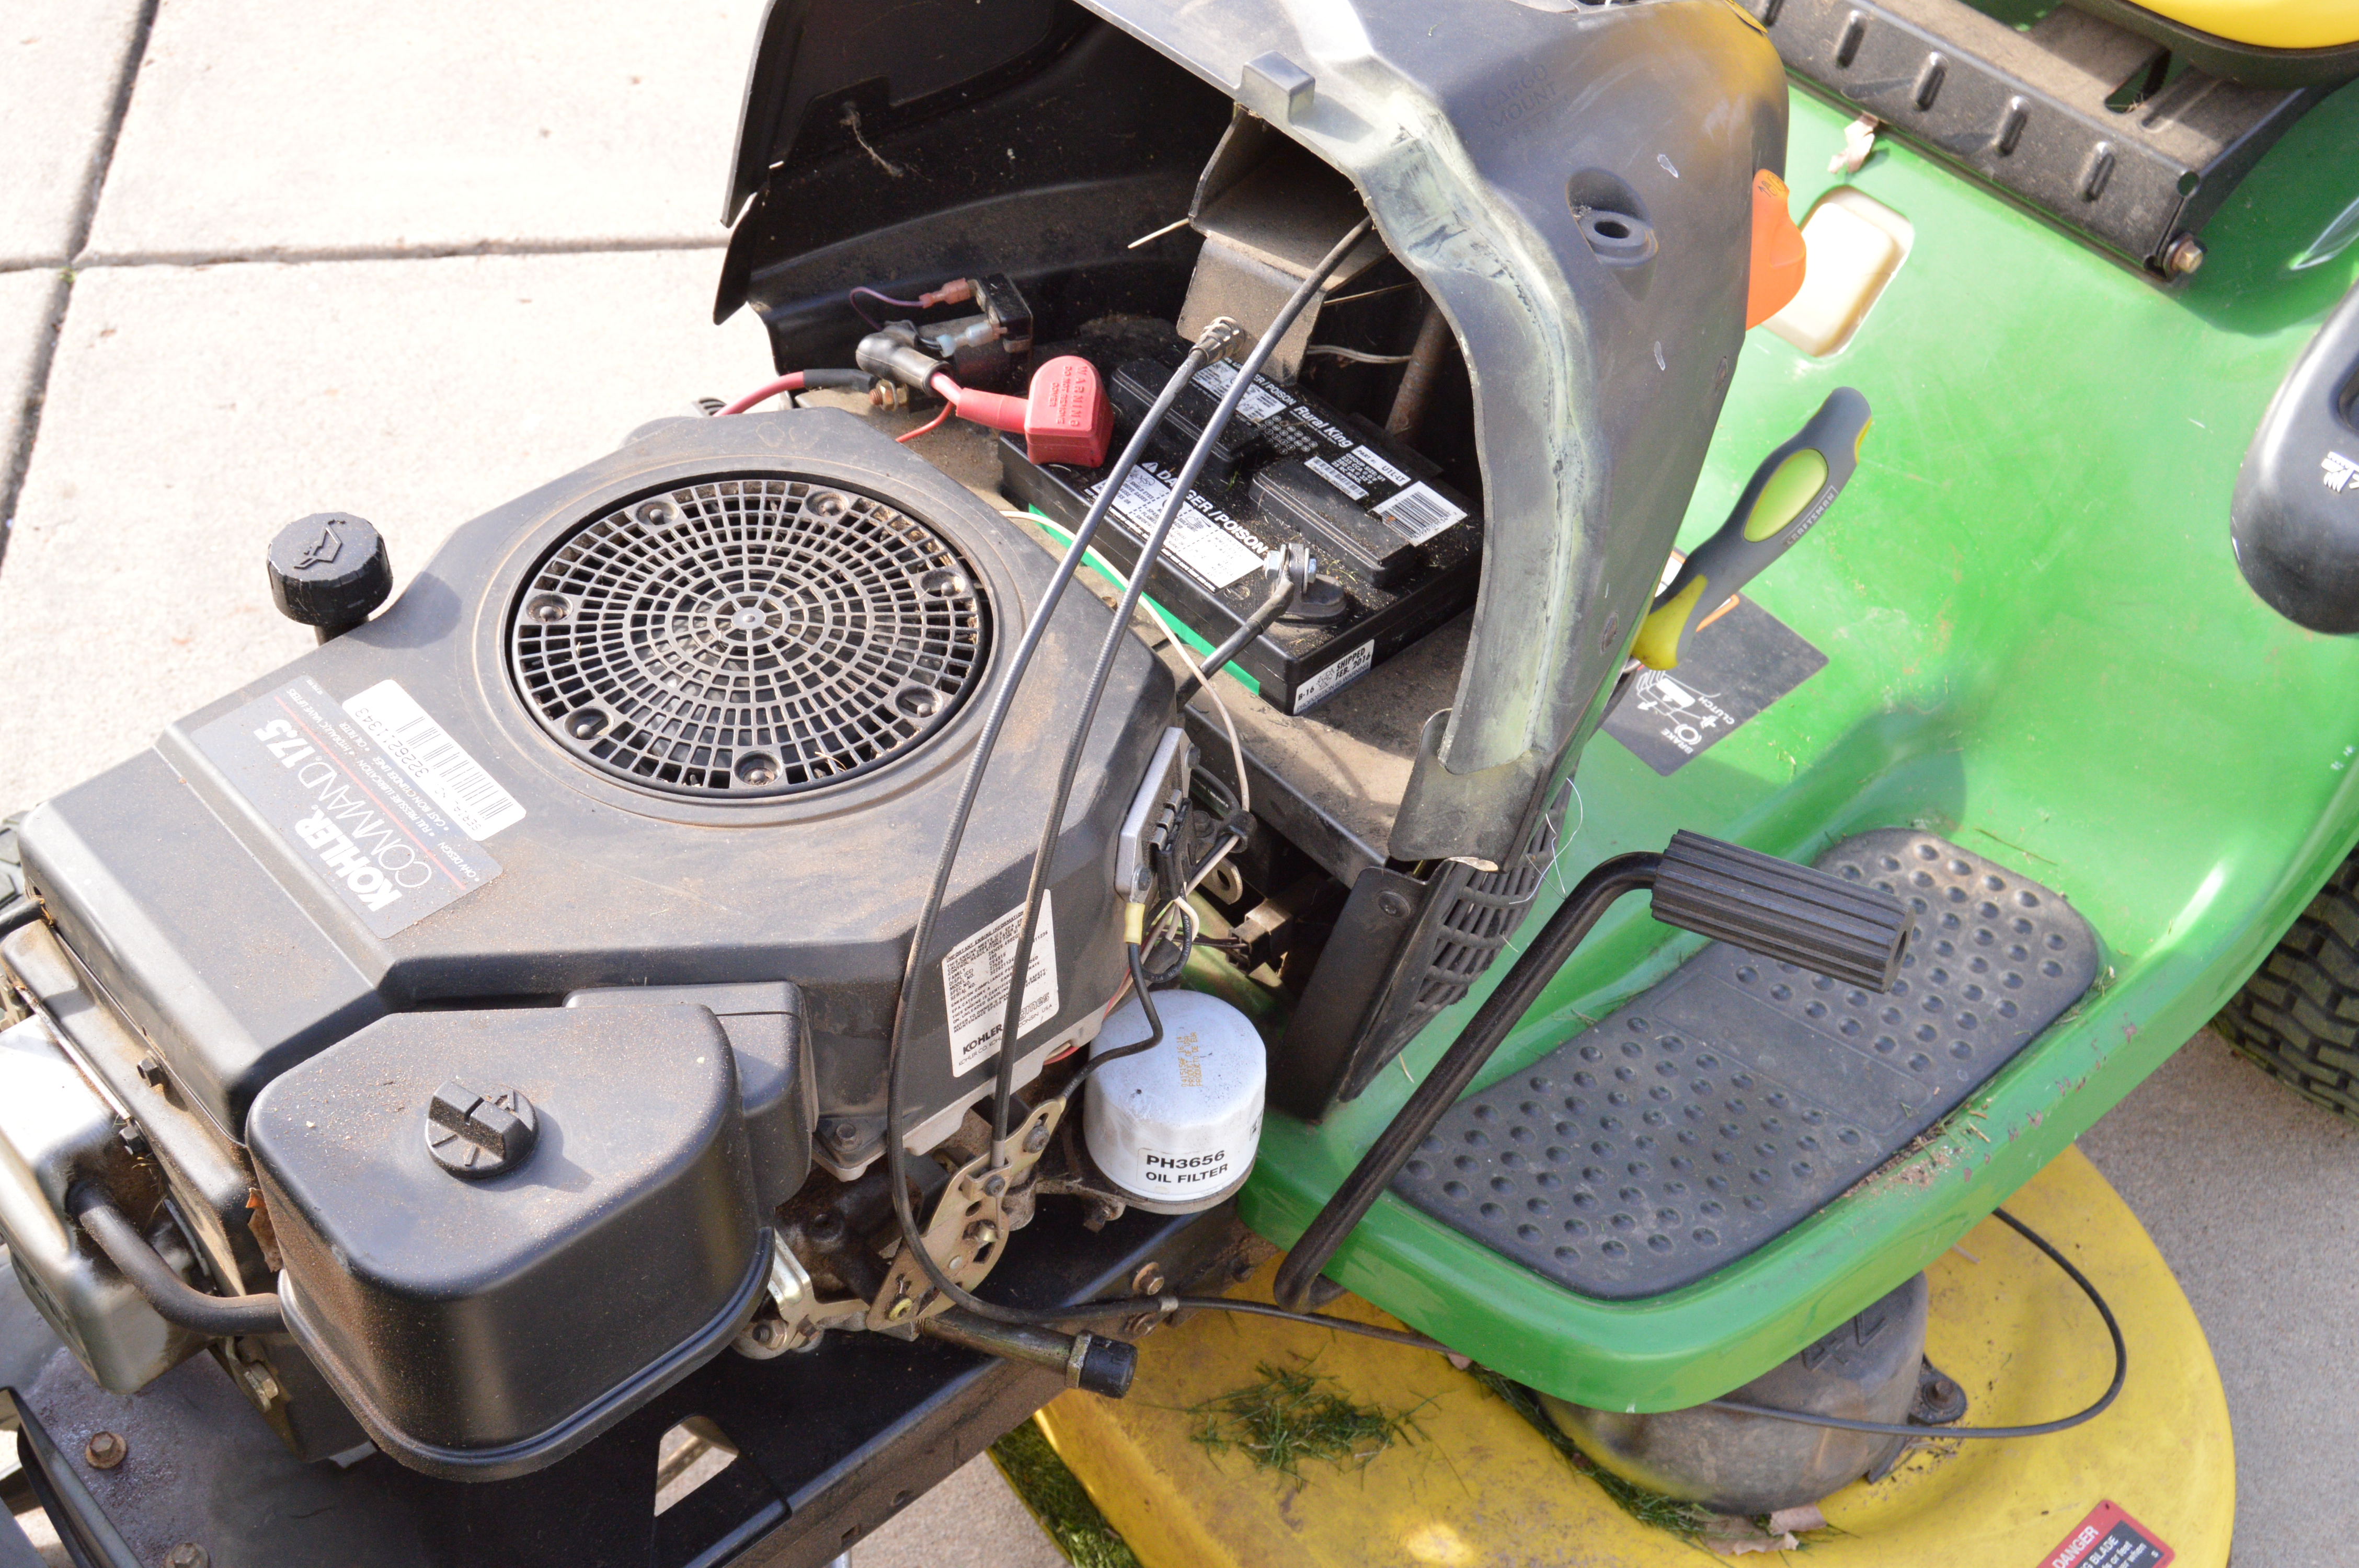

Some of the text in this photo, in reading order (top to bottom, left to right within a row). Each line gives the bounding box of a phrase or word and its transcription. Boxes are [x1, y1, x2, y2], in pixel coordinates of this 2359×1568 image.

[1048, 382, 1059, 407] COVER
[1056, 366, 1072, 424] DO NOT REMOVE
[1069, 366, 1088, 427] WARNING
[1292, 403, 1330, 431] Rural
[1321, 424, 1356, 450] King
[1345, 452, 1366, 468] GROUP
[1350, 462, 1364, 472] CCA
[1357, 449, 1371, 459] PART
[1380, 465, 1405, 483] U1L-LT
[1119, 488, 1131, 497] AUSE
[1133, 491, 1148, 502] GASES
[1142, 491, 1154, 500] EYES
[1785, 492, 1835, 545] CRAFTSMAN
[1336, 646, 1366, 671] SHIPPED
[1298, 651, 1370, 701] B-16 FEB. 2016
[1297, 683, 1334, 711] PROPOSITION
[1698, 696, 1735, 724] CLUTCH
[285, 687, 352, 752] HYDRAULIC VALVE LIFTERS
[338, 721, 368, 748] OIL FILTER
[353, 706, 430, 779] 3226211343
[1662, 728, 1693, 754] BRAKE
[251, 715, 439, 893] COMMAND 17.5
[355, 758, 432, 833] FULL PRESSURE LUBRICATION
[372, 755, 446, 827] CAST IRON CYLINDER LINER
[289, 808, 403, 912] KOHLER
[437, 840, 477, 879] OHV DESIGN
[946, 910, 1023, 963] IMPORTANT ENGINE INFORMATION
[947, 952, 975, 972] CALIFORNIA
[989, 937, 998, 946] AND
[1000, 927, 1013, 939] LATER
[947, 959, 957, 969] THIS
[959, 947, 976, 961] ENGINE
[978, 937, 992, 949] MEETS
[948, 960, 968, 976] CONTROL
[970, 939, 1001, 961] REGULATIONS
[1003, 932, 1012, 941] FOR
[948, 967, 965, 982] FAMILY
[949, 978, 965, 991] MODEL
[989, 952, 1005, 966] CV491S
[949, 974, 962, 986] DISPL
[964, 967, 974, 977] (CC)
[951, 987, 966, 1001] SERIAL
[990, 955, 1015, 976] 322621134
[950, 985, 961, 996] SPEC
[951, 971, 1003, 1007] EMISSION COMPLIANCE
[953, 1009, 963, 1019] THIS
[964, 998, 980, 1011] ENGINE
[989, 978, 1011, 996] CERTIFIED
[961, 1000, 986, 1018] UNLEADED
[987, 985, 1009, 1002] GASOLINE
[954, 1018, 967, 1030] REFER
[977, 999, 997, 1014] OWNER'S
[954, 1000, 1001, 1033] MAINTENANCE SPECS
[963, 991, 1050, 1055] KOHLER gines
[958, 1051, 977, 1066] KOHLER
[1018, 1012, 1038, 1028] CONSIN
[1041, 1003, 1052, 1013] USA
[1185, 1059, 1195, 1087] PRODUCT
[1192, 1055, 1203, 1086] PRODUCTO
[1146, 1150, 1225, 1169] PH3656
[1146, 1163, 1228, 1183] OIL FILTER
[2052, 1525, 2099, 1568] DANGER
[2089, 1535, 2119, 1564] BLADE
